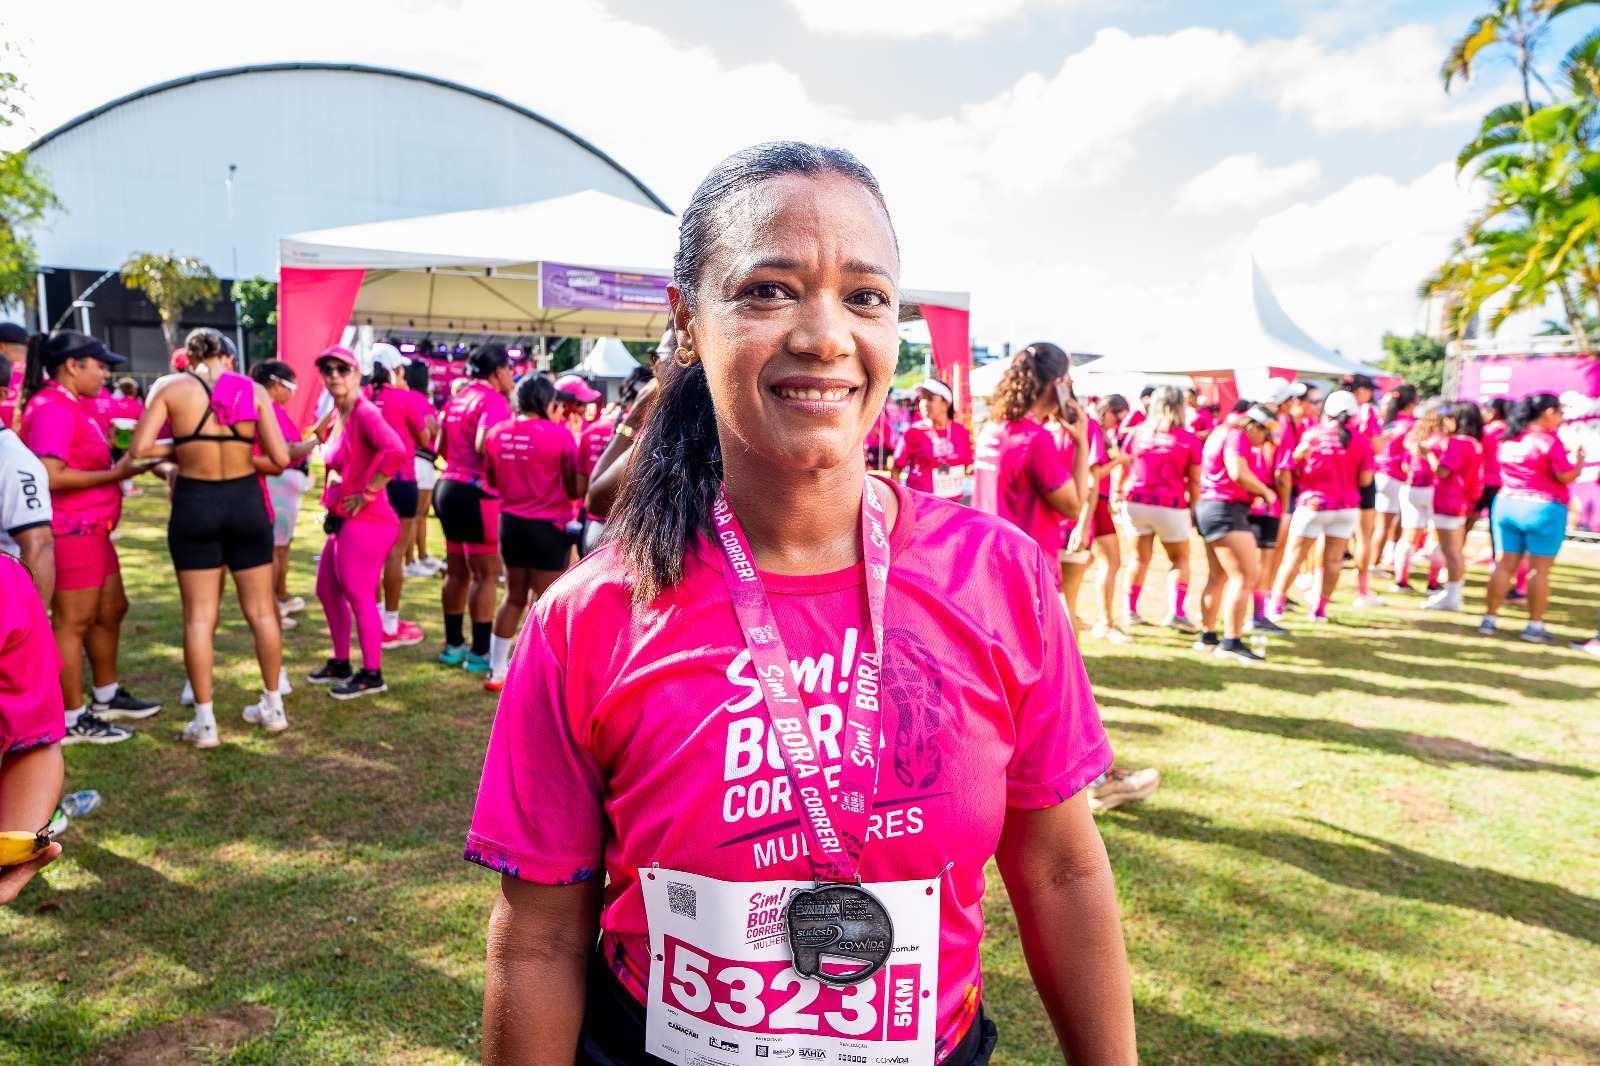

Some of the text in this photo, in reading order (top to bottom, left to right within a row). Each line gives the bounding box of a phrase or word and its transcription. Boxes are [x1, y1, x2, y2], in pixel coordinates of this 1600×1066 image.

[864, 511, 890, 552] Sim!
[720, 530, 758, 583] CORRER!
[726, 627, 859, 713] Sm!
[758, 664, 799, 703] Sim!
[848, 652, 879, 769] Sim! BORA
[774, 717, 820, 779] BORA
[800, 786, 843, 854] CORRER!
[840, 790, 851, 811] Sim!
[850, 791, 860, 813] BORA
[748, 886, 786, 912] Sim!
[796, 926, 834, 937] sudesb
[669, 944, 878, 1036] 5323
[893, 978, 914, 1028] 5KM
[667, 1021, 699, 1039] CAMAÇARI
